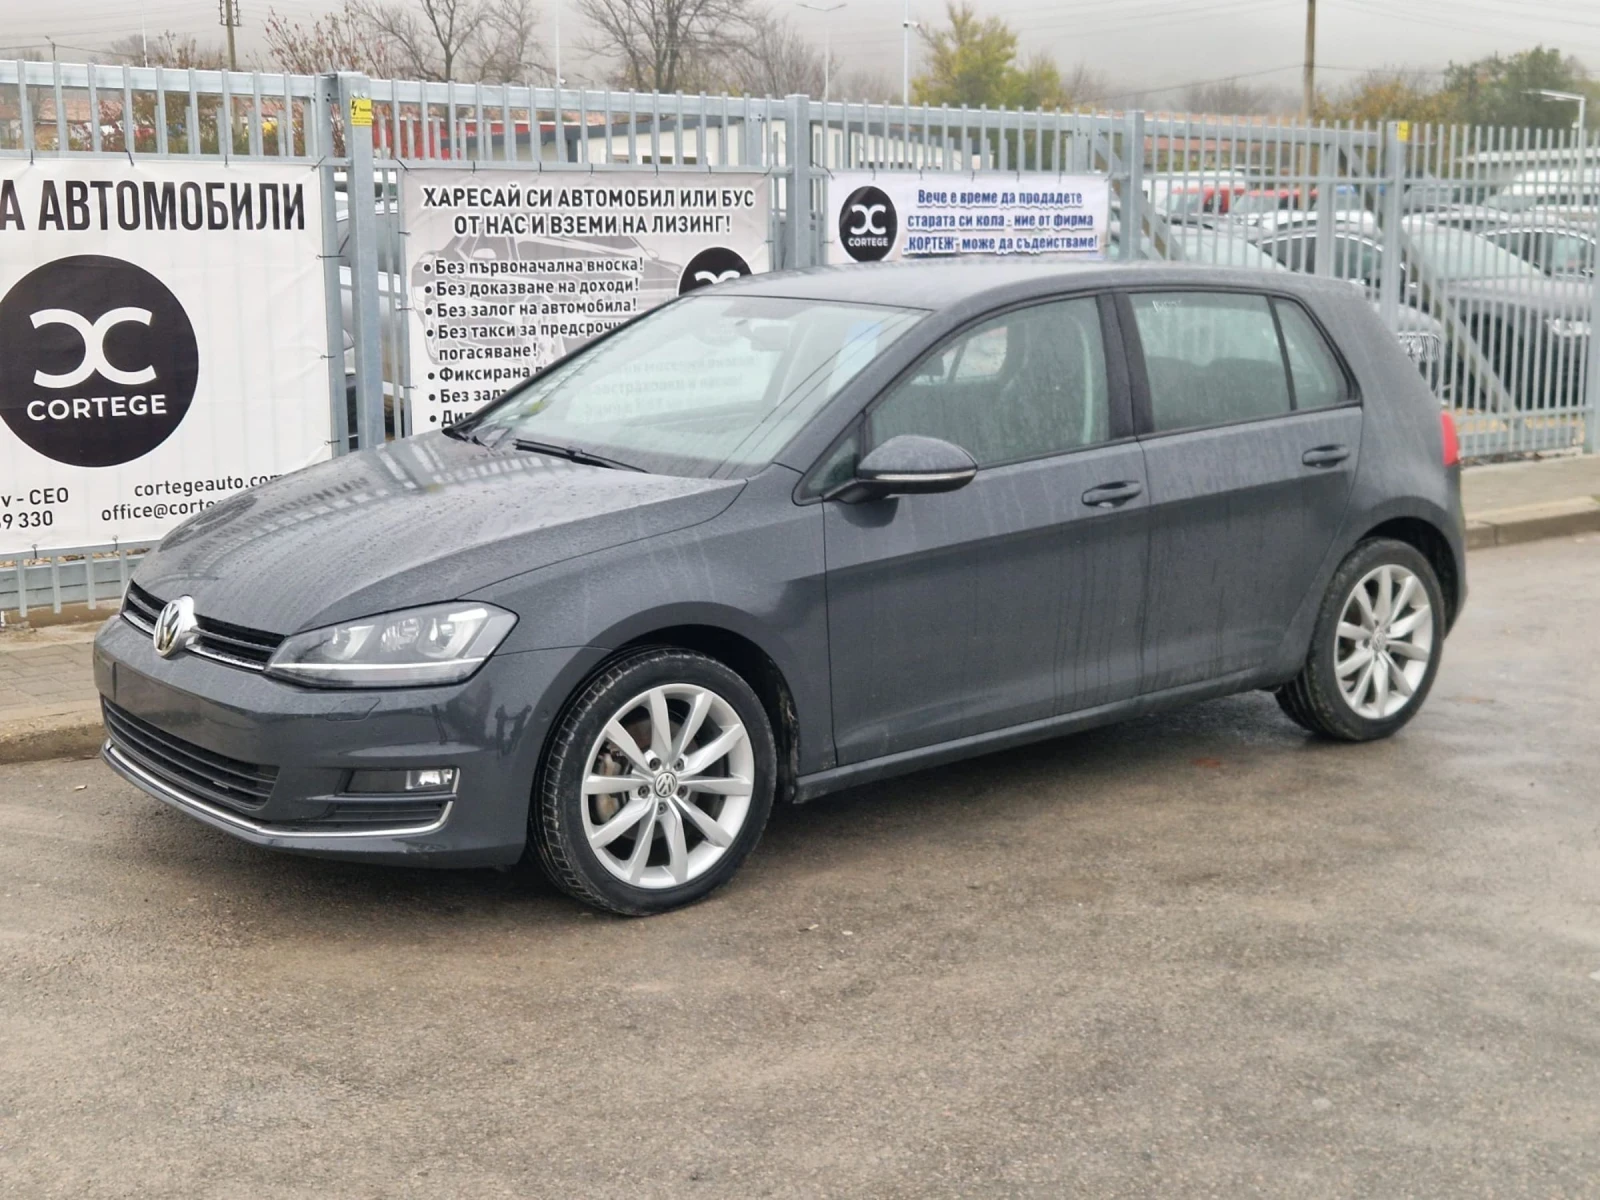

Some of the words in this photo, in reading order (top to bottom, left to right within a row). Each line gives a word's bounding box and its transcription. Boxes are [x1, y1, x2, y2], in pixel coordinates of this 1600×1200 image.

[423, 184, 521, 207] ХАРЕСАЙ
[526, 189, 553, 207] СИ
[557, 189, 675, 207] АВТОМОБИЛ
[680, 190, 717, 207] ИЛИ
[721, 190, 754, 208] БУС
[918, 189, 947, 204] Вече
[950, 191, 957, 204] е
[960, 191, 998, 205] време
[1001, 191, 1016, 206] да
[1019, 191, 1083, 206] продадете
[38, 180, 305, 231] АВТОМОБИЛИ
[454, 216, 481, 235] ОТ
[486, 216, 527, 235] НАС
[532, 216, 544, 234] И
[550, 216, 618, 234] ВЗЕМИ
[623, 216, 648, 234] НА
[652, 215, 731, 233] ЛИЗИНГ!
[907, 215, 956, 229] старата
[959, 215, 973, 227] си
[976, 215, 1005, 227] кола
[1014, 215, 1035, 227] ние
[1038, 215, 1051, 227] от
[1053, 213, 1094, 228] фирма
[848, 237, 889, 247] CORTEGE
[962, 238, 996, 250] може
[998, 238, 1014, 250] да
[435, 260, 465, 274] Без
[469, 261, 584, 277] първоначална
[587, 257, 643, 272] вноска!
[436, 282, 466, 296] Без
[469, 282, 554, 298] доказване
[558, 282, 576, 293] на
[579, 278, 639, 294] доходи!
[437, 303, 467, 318] Без
[470, 304, 516, 317] залог
[519, 303, 537, 315] на
[541, 298, 637, 315] автомобила!
[438, 325, 468, 339] Без
[471, 325, 516, 338] такси
[519, 325, 537, 337] за
[439, 343, 537, 361] погасяване!
[439, 367, 531, 382] Фиксирана
[440, 389, 469, 403] Без
[26, 394, 167, 421] CORTEGE
[29, 487, 69, 506] CEO
[18, 510, 53, 528] 330
